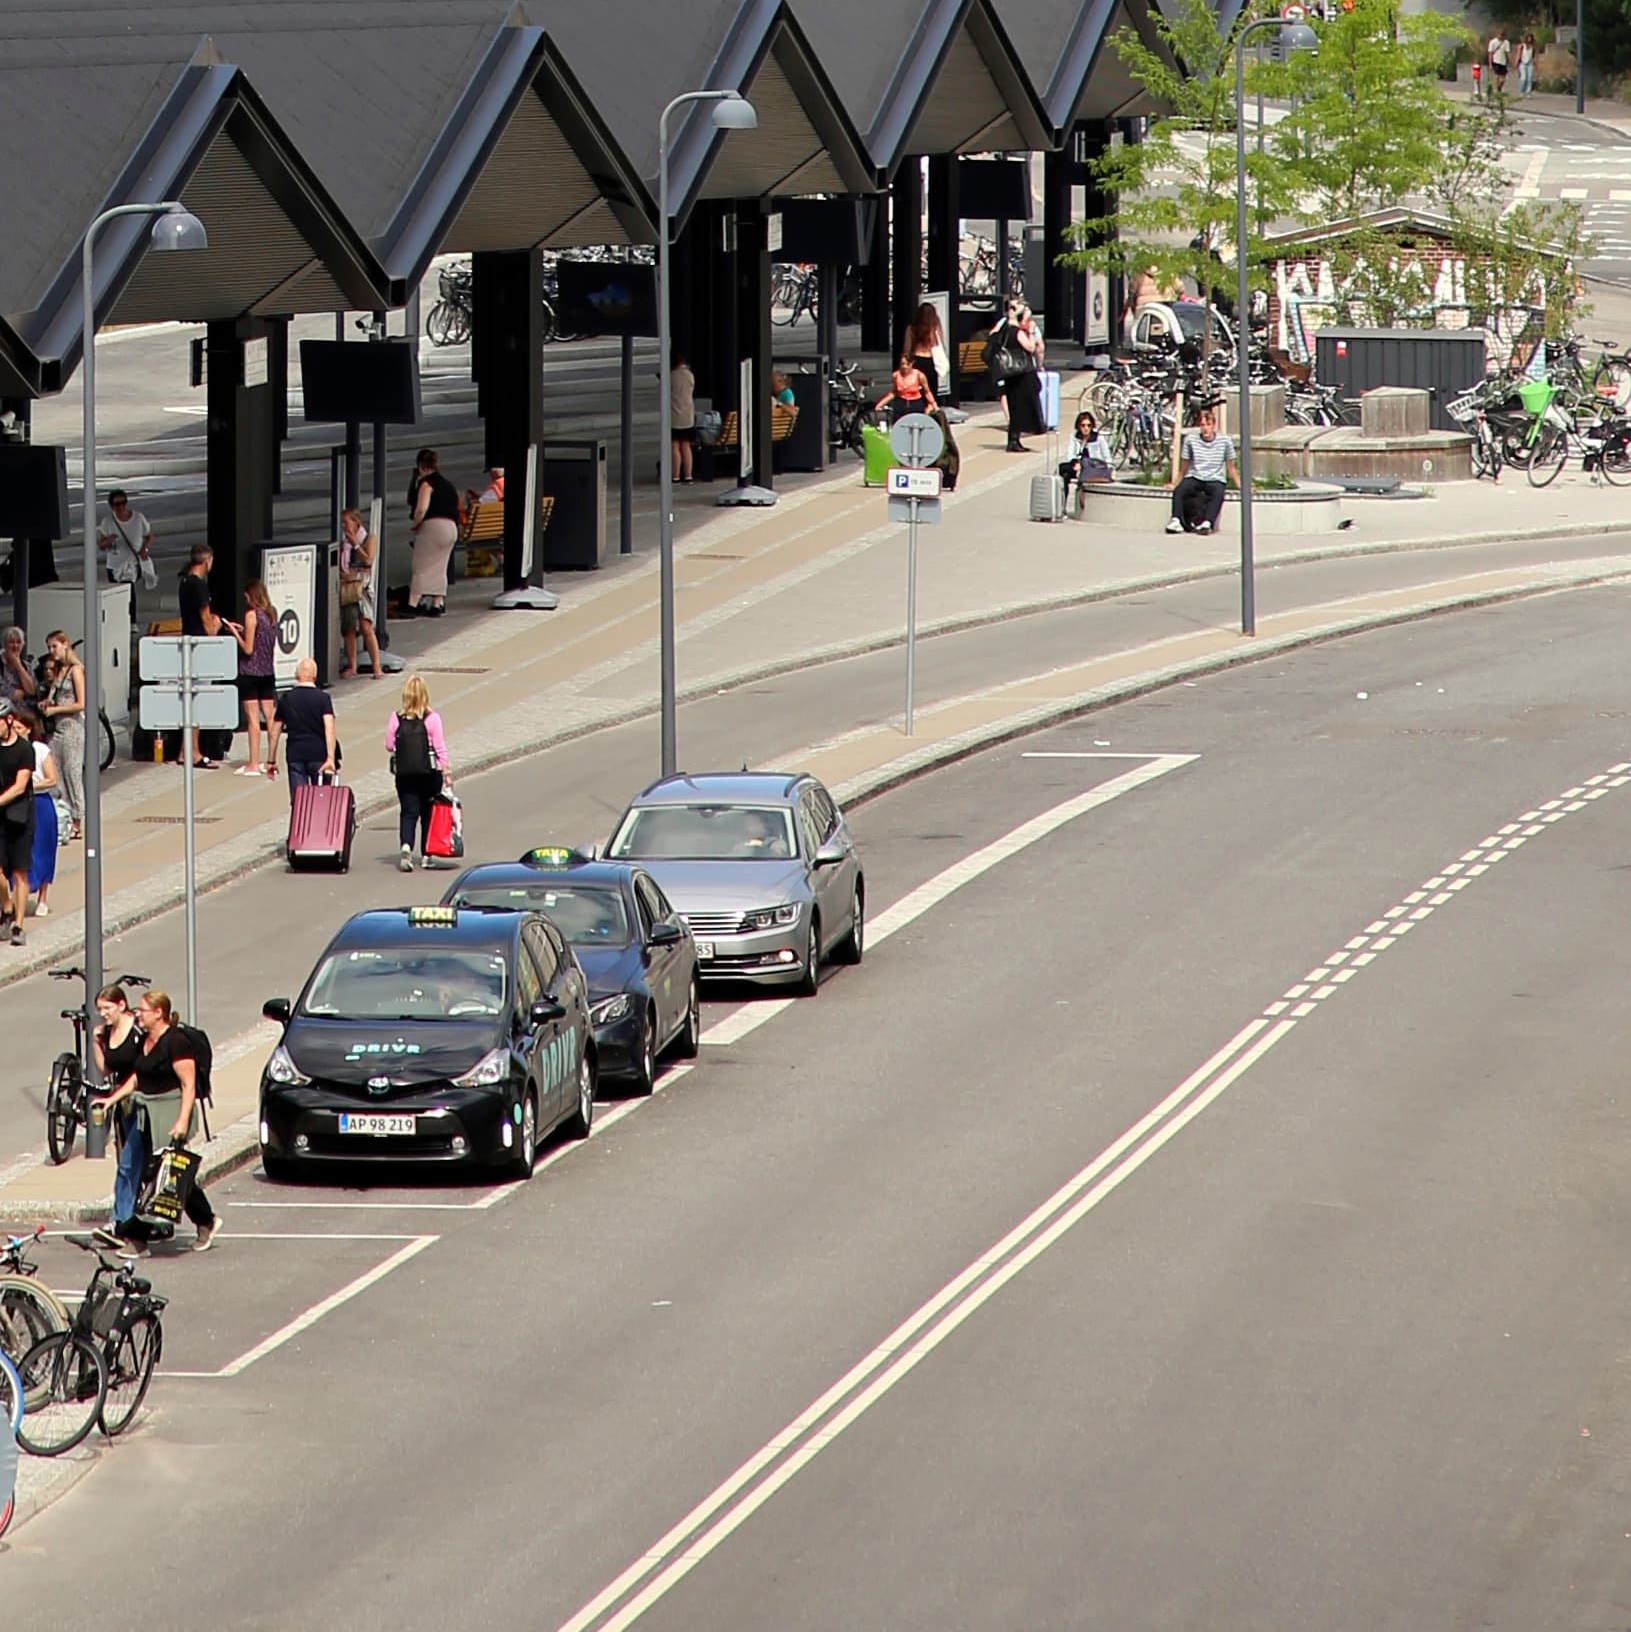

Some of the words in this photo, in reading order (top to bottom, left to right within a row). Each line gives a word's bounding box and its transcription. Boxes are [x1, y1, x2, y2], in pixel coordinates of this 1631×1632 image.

[280, 619, 297, 644] 10
[411, 906, 453, 920] TAXI
[541, 1025, 576, 1096] DRIVR
[349, 1118, 367, 1130] AP
[370, 1119, 386, 1131] 98
[389, 1119, 413, 1132] 219
